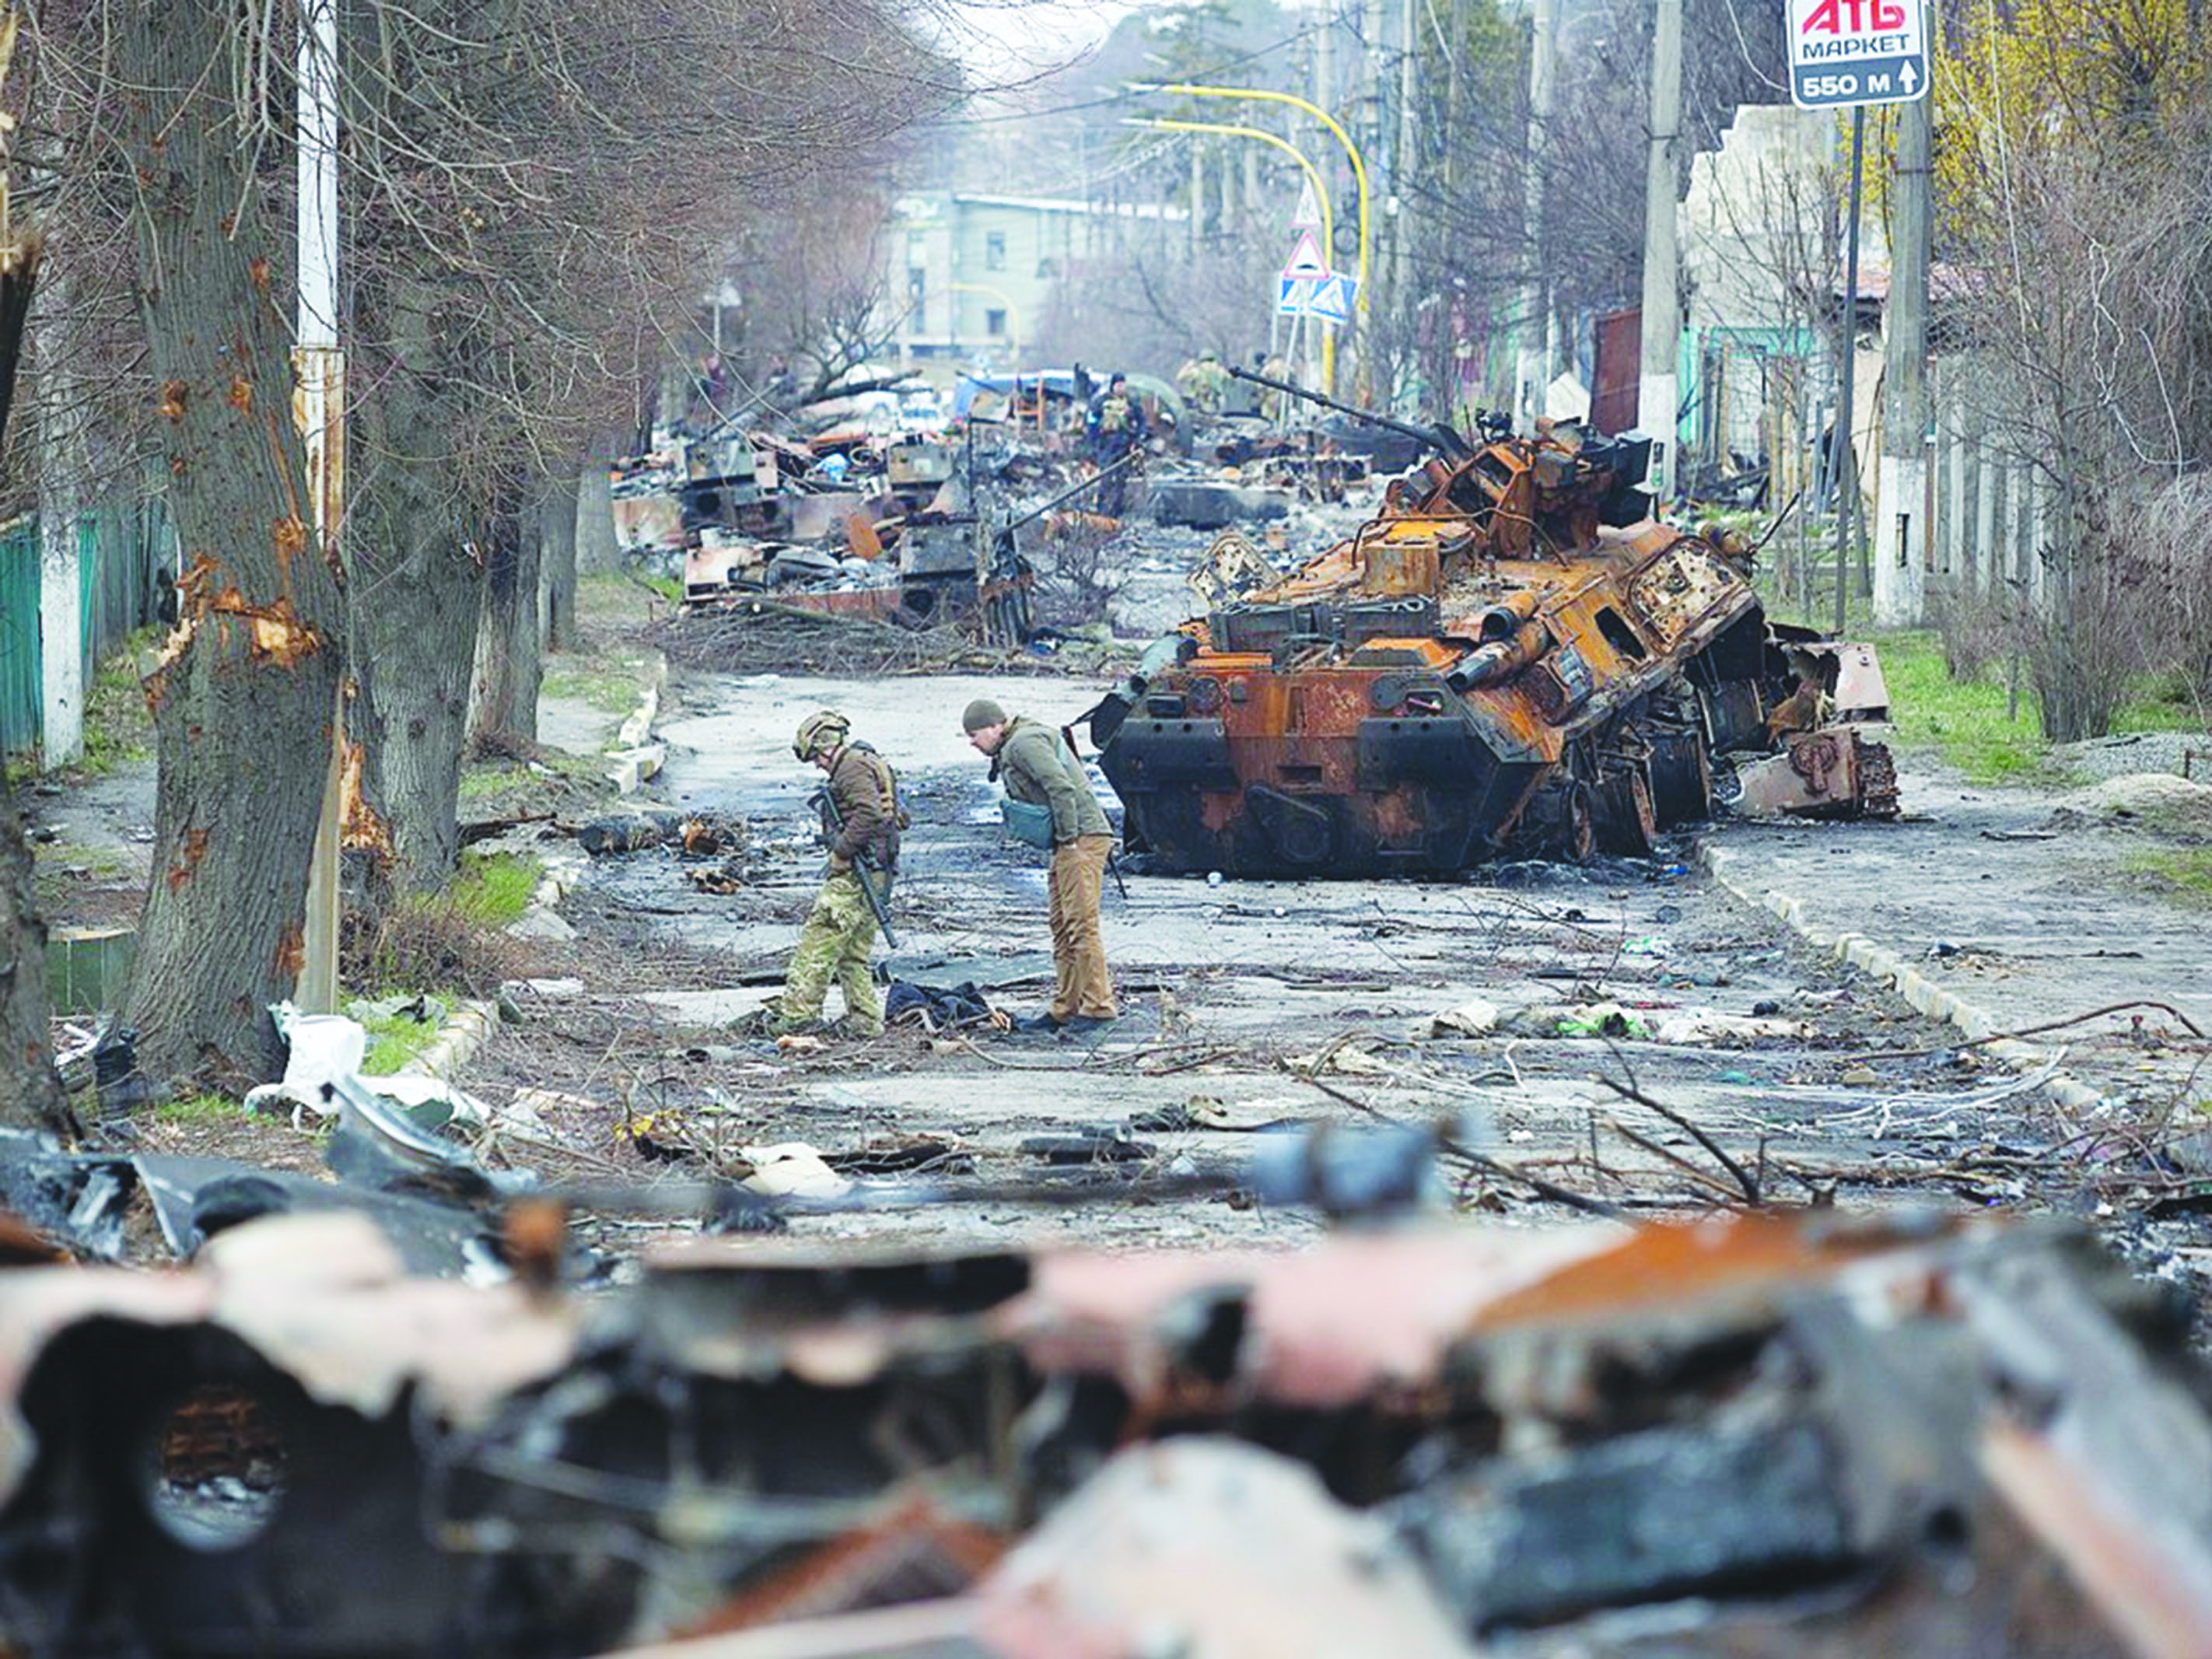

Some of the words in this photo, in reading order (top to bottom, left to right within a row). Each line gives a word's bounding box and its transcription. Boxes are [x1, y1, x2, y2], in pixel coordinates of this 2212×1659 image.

[1803, 33, 1909, 58] МАРКЕТ
[1803, 75, 1858, 97] 550
[1867, 73, 1890, 93] М
